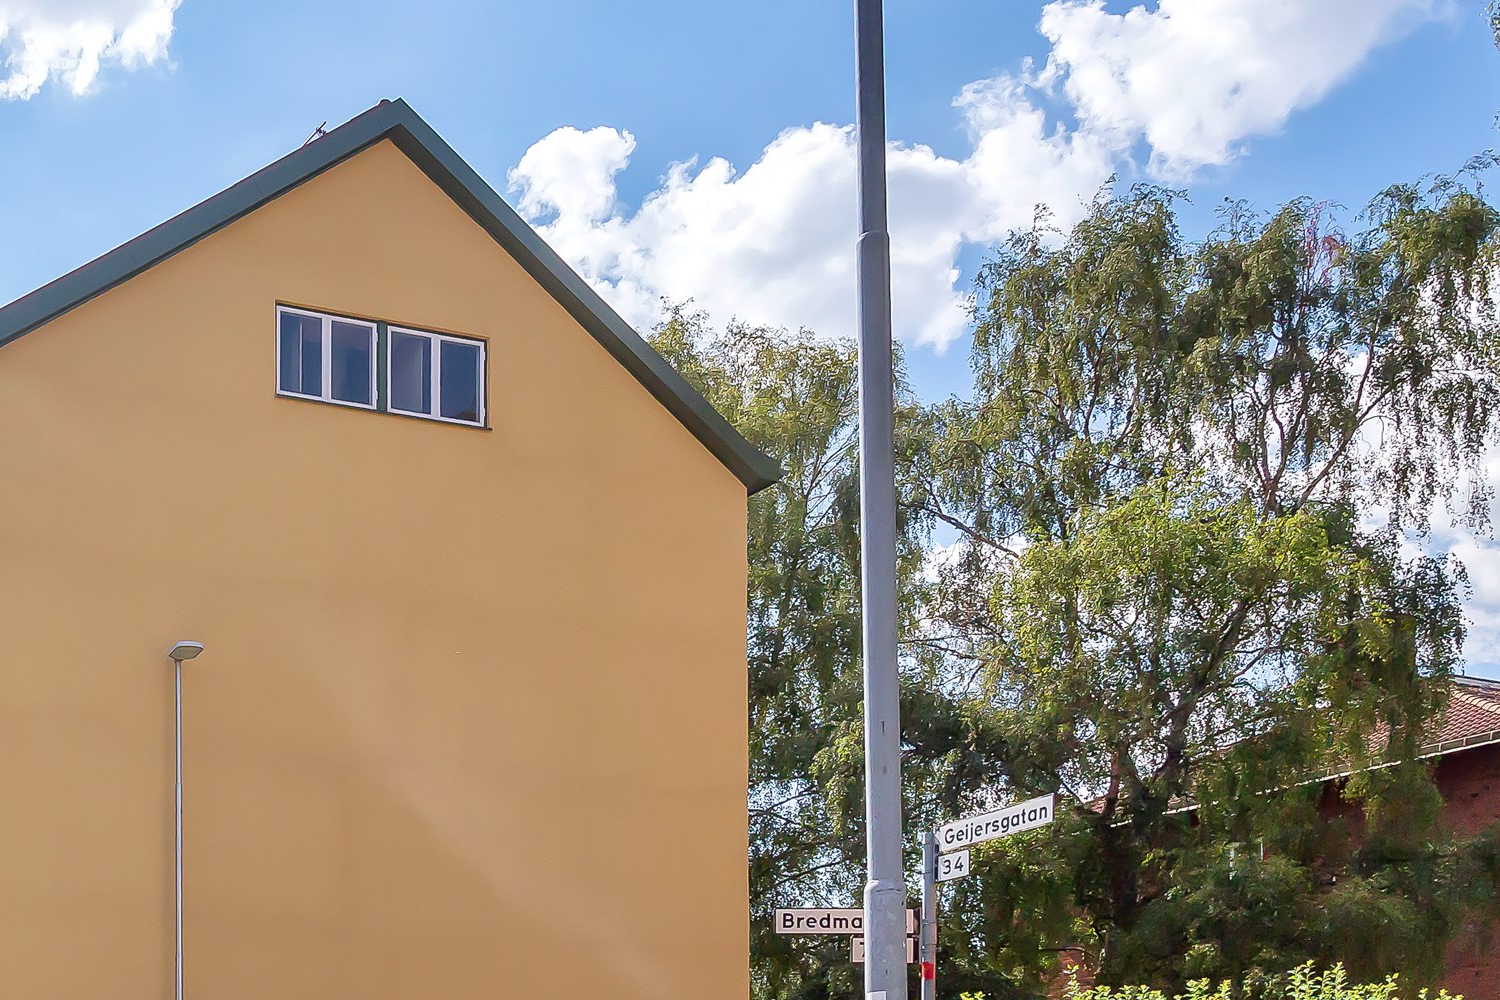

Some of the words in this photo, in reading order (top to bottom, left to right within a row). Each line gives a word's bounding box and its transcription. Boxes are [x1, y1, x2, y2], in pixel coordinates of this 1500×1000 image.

[944, 806, 1048, 844] Geijersgatan
[942, 856, 964, 875] 34
[782, 913, 863, 929] Bredma
